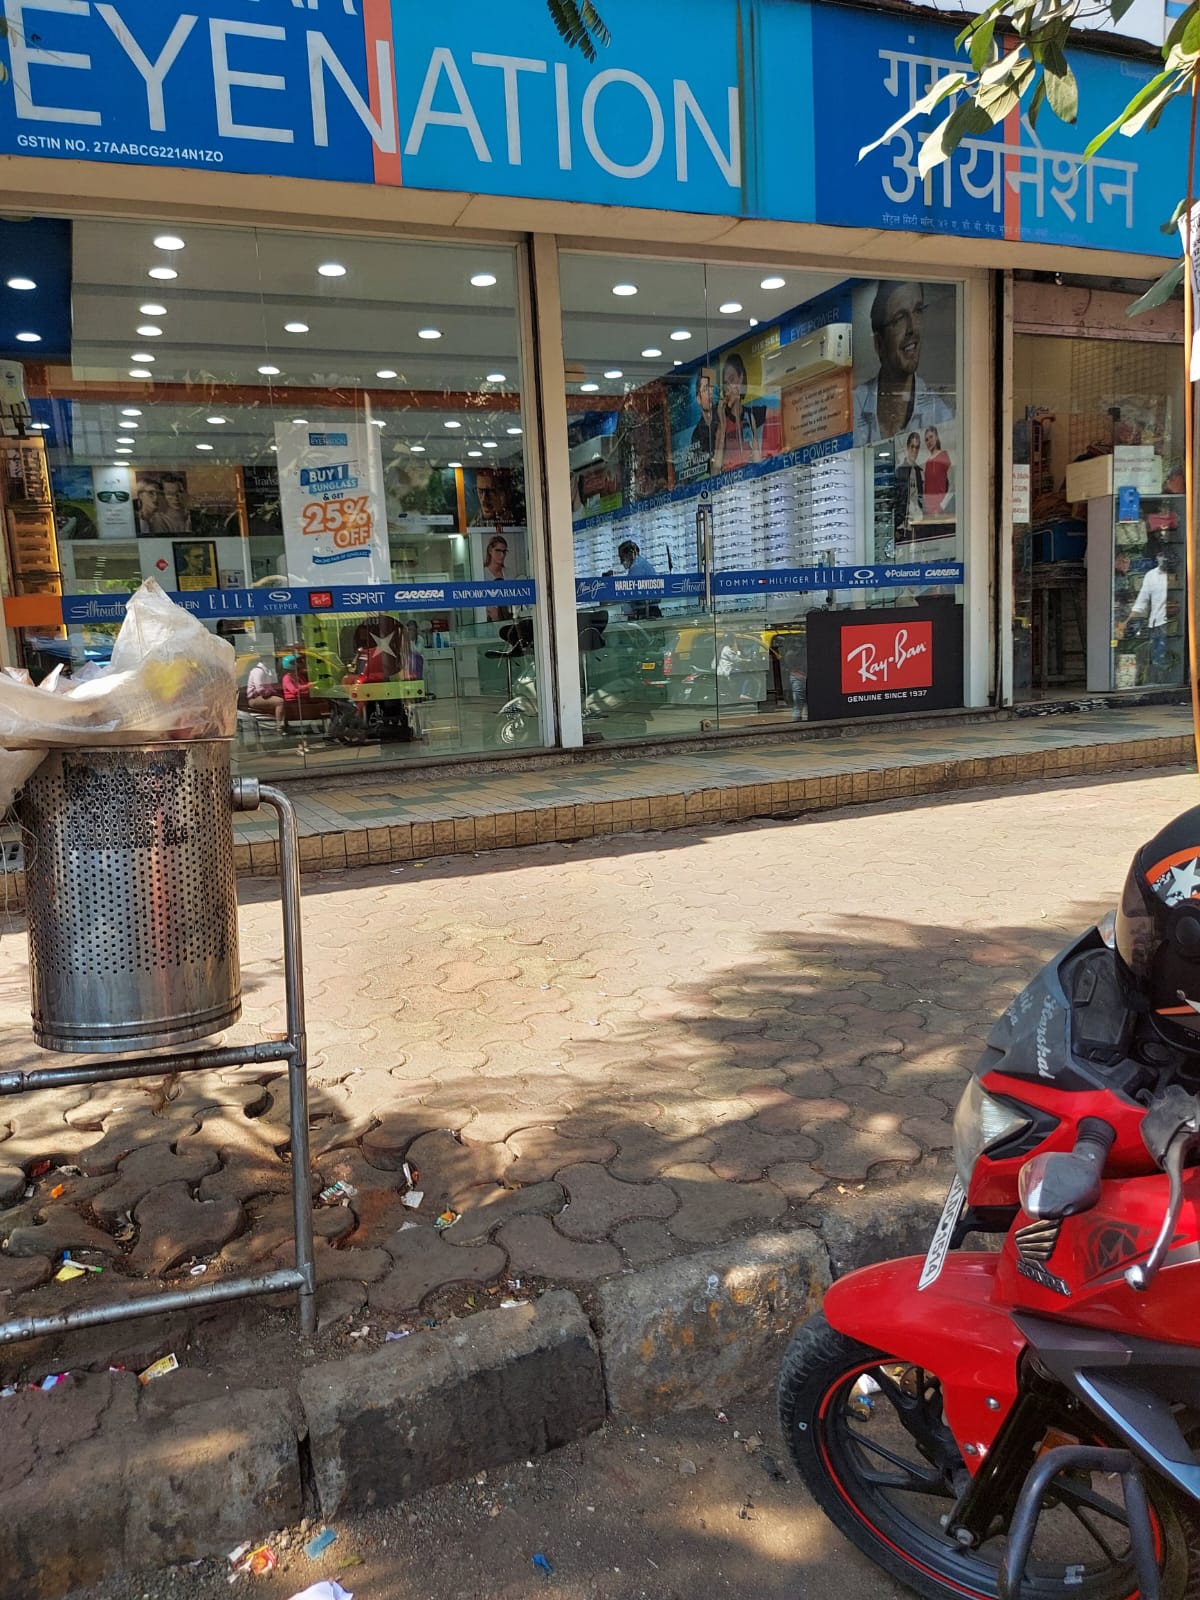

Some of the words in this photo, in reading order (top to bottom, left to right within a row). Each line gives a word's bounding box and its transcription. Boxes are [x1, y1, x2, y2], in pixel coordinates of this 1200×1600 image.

[3, 0, 742, 188] EYENATION
[17, 134, 61, 150] GSTIN
[65, 139, 90, 152] NO.
[783, 453, 801, 468] EYE
[803, 440, 839, 464] POWER
[309, 469, 334, 483] BUY
[338, 466, 343, 480] 1
[312, 479, 357, 493] SUNGLASS
[304, 497, 371, 533] 25%
[336, 527, 369, 545] OFF
[720, 578, 755, 587] TOMMY
[769, 576, 809, 585] HILFIGER
[814, 569, 844, 584] ELLE
[891, 568, 921, 578] Polaroid
[614, 578, 665, 591] HARLEY-DAVIDSON
[209, 592, 255, 610] ELLE
[264, 603, 299, 611] STEPPER
[342, 591, 386, 606] ESPRIT
[394, 589, 444, 600] CARRERA
[452, 589, 488, 600] EMPORIO
[497, 586, 531, 599] ARMANI
[848, 693, 882, 703] GENUINE
[884, 691, 907, 700] SINCE
